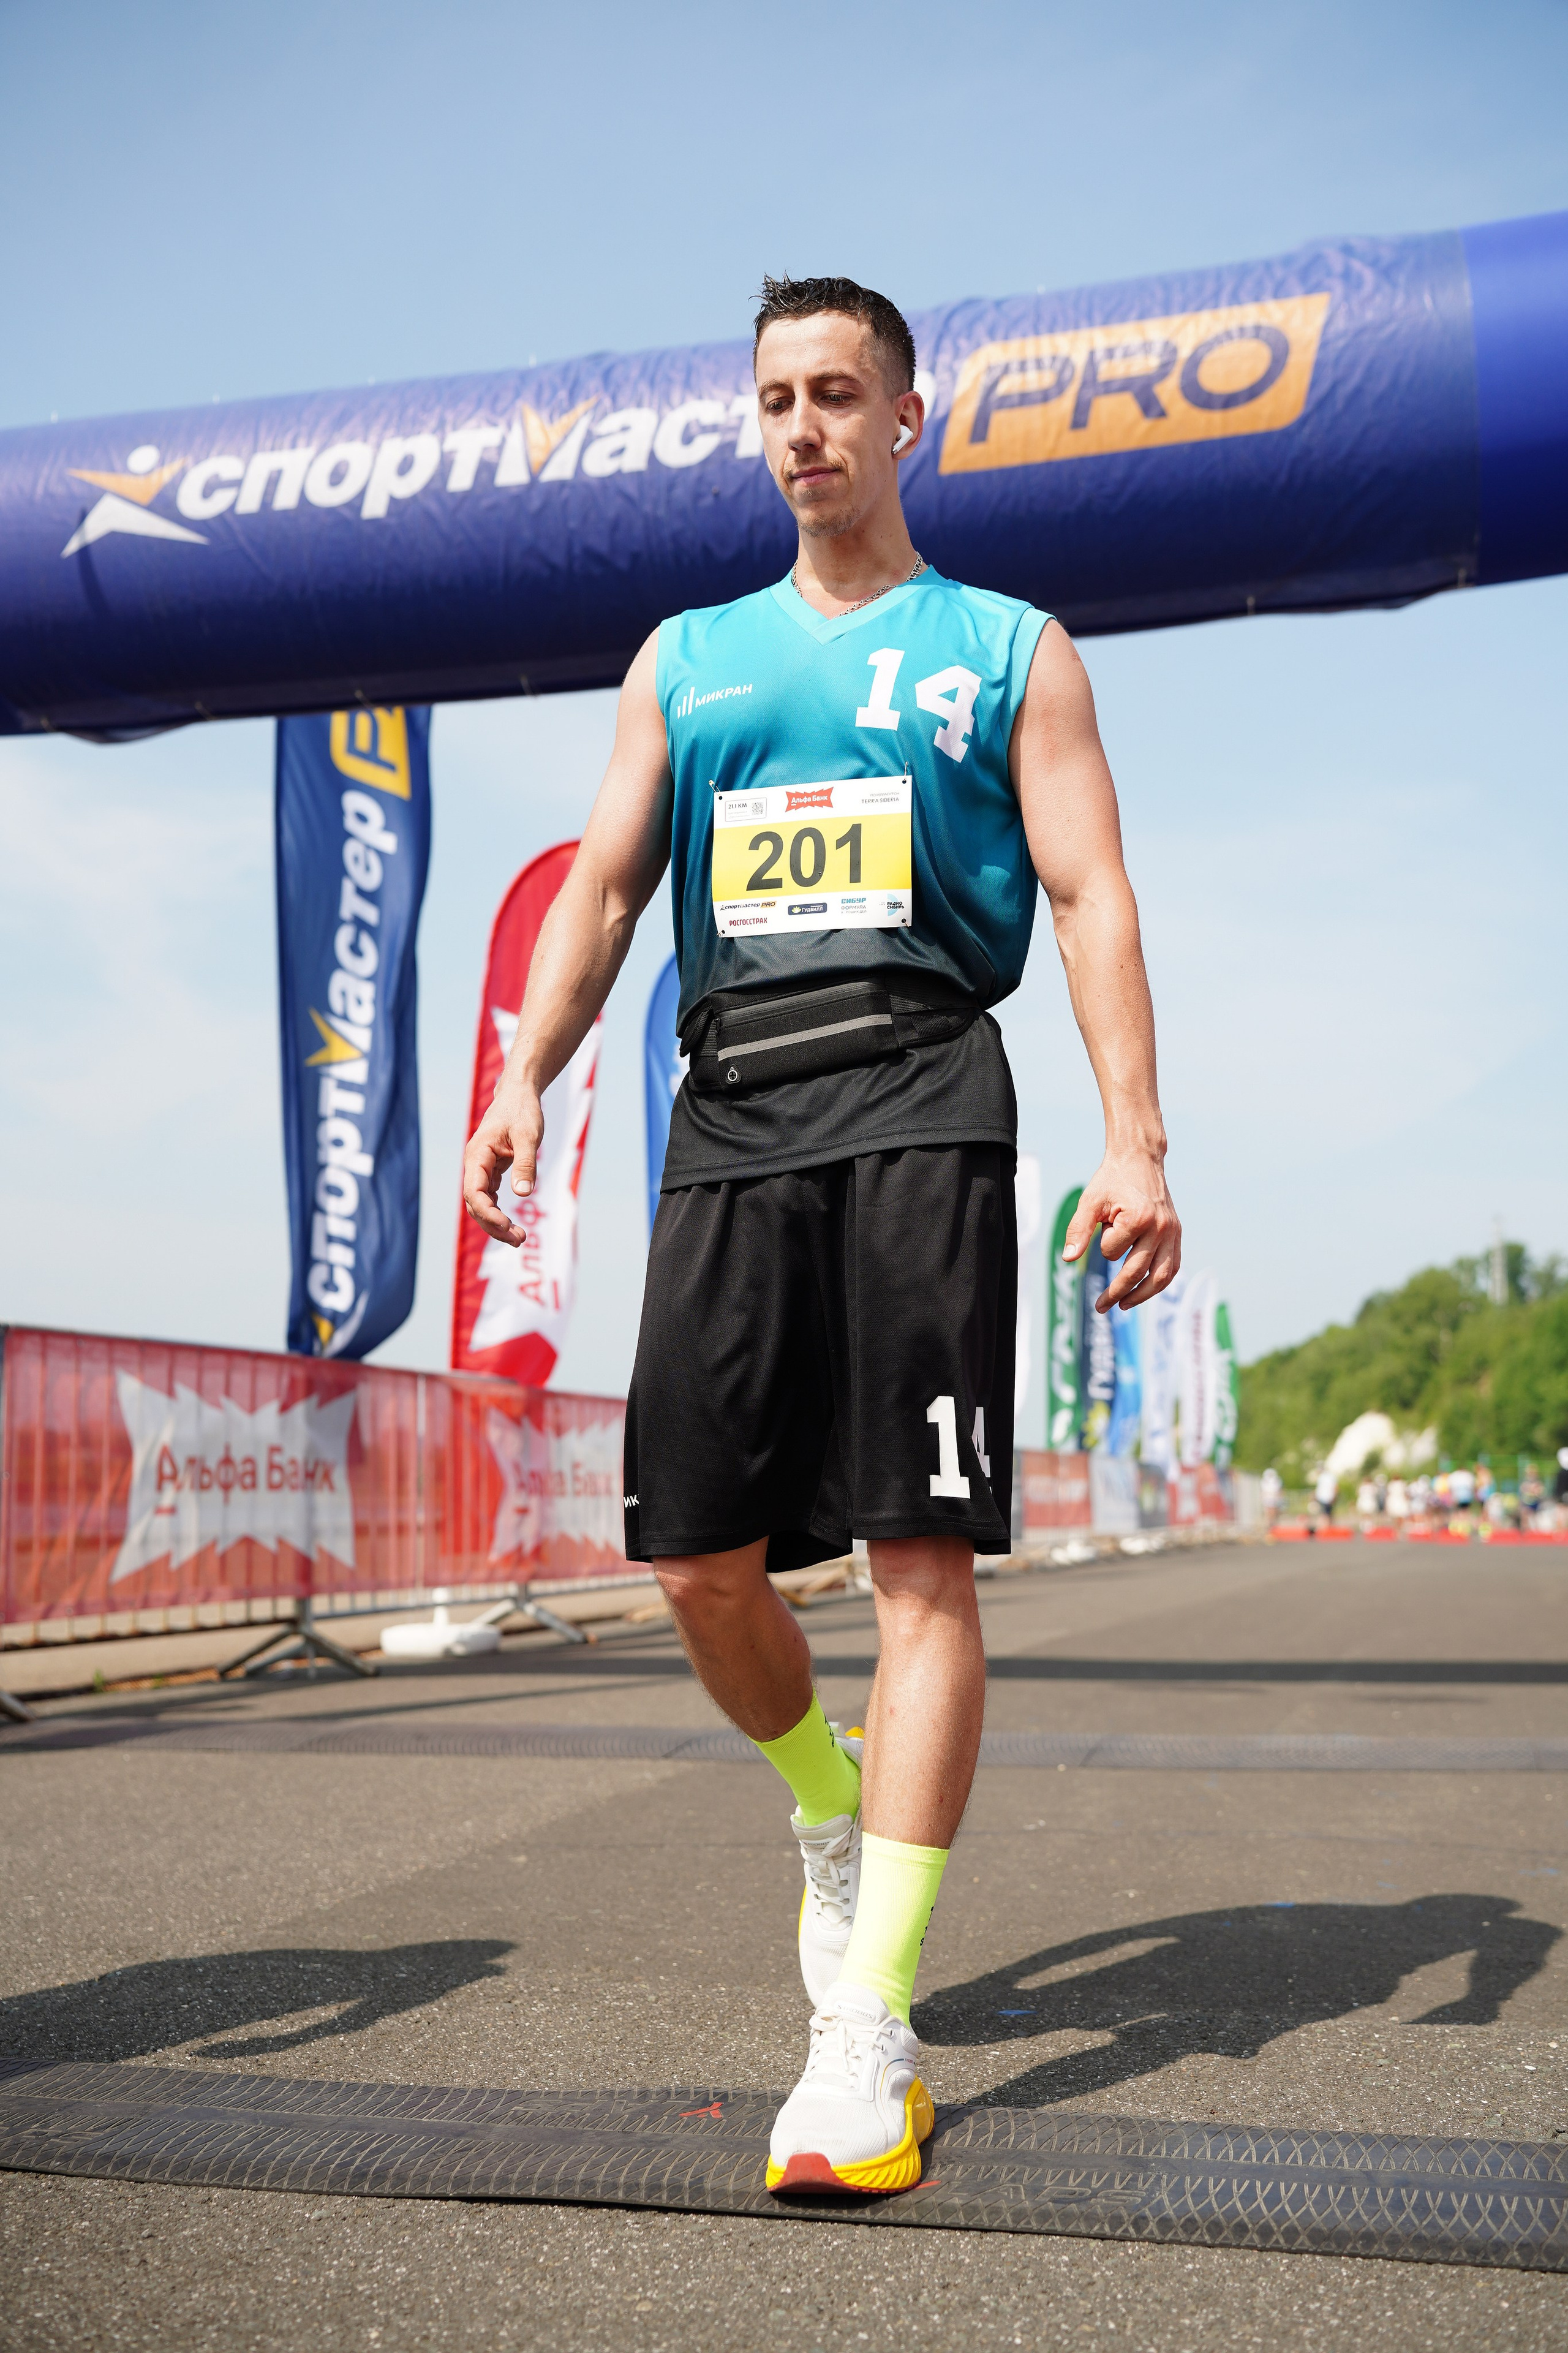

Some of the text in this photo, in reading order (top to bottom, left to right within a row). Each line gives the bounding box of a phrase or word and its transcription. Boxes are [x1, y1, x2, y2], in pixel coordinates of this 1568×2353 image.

[970, 323, 1290, 445] PRO
[695, 683, 753, 708] МИКРАН
[855, 647, 982, 763] 14
[791, 796, 812, 804] Альфа
[746, 823, 862, 891] 201
[729, 917, 767, 926] РОСГОССТРАХ
[156, 1443, 336, 1507] Альфа Банк
